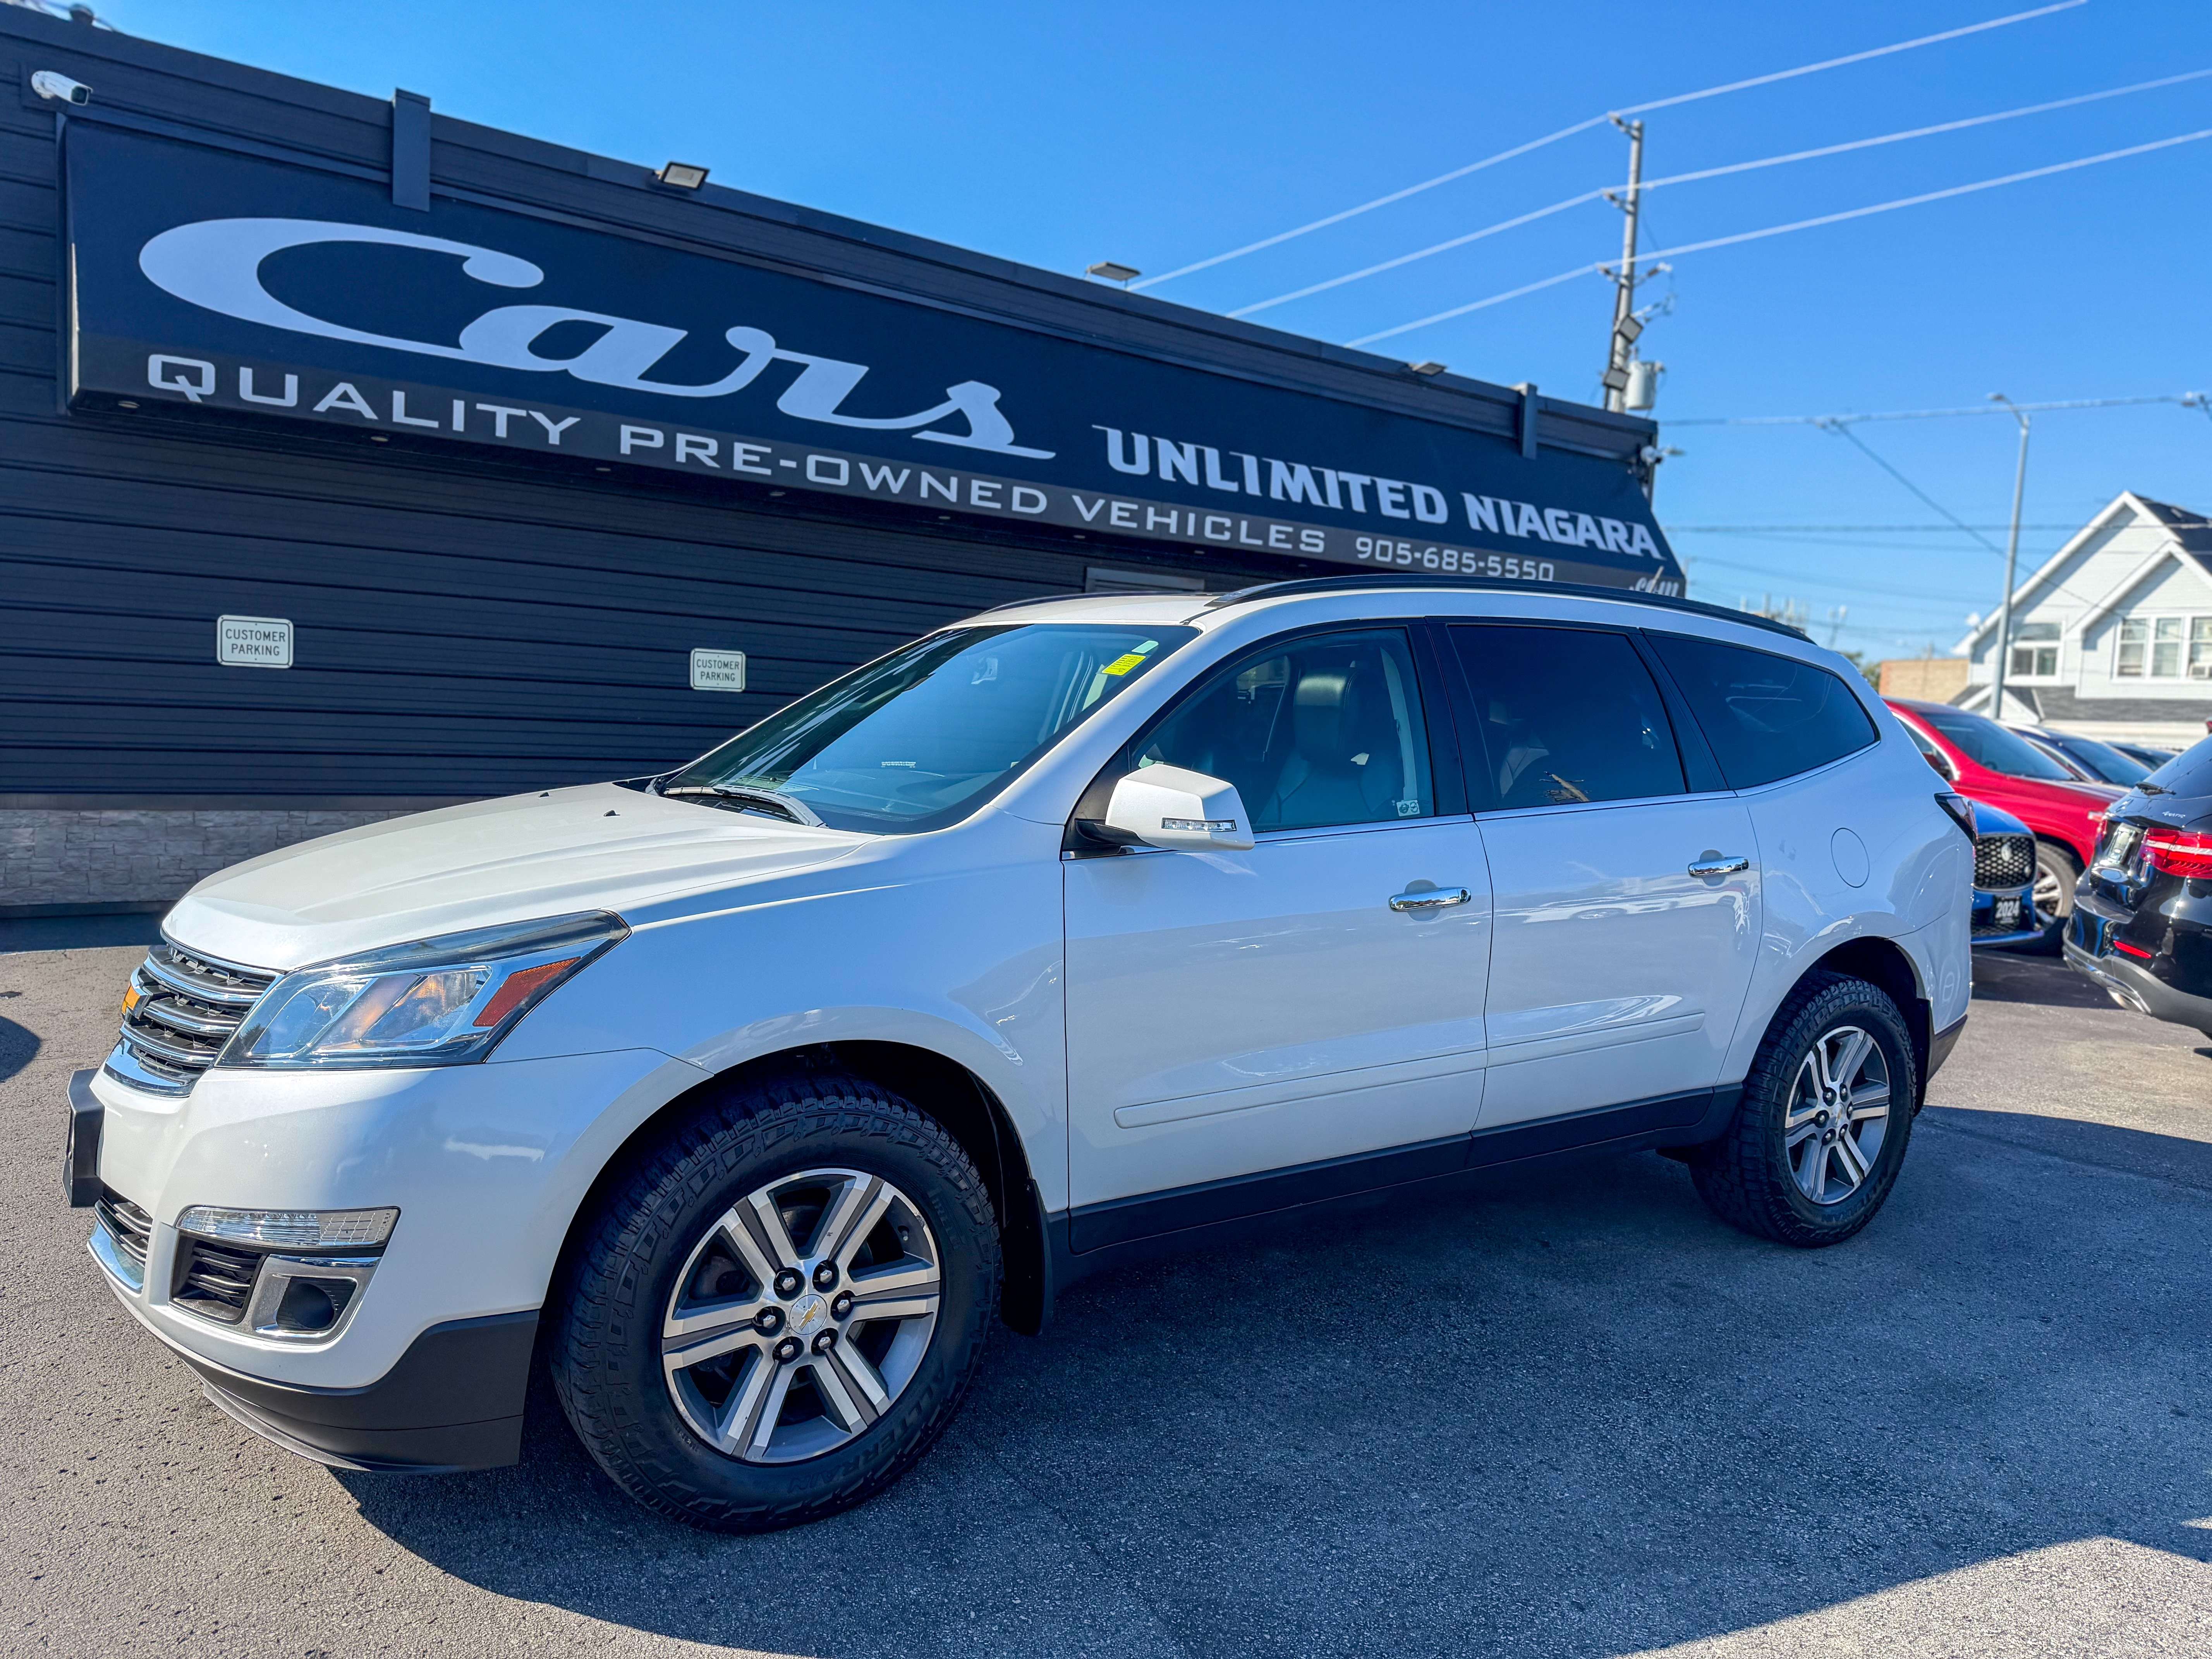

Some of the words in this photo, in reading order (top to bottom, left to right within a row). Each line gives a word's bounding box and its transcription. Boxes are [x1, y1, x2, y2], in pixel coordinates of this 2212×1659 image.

[139, 217, 1056, 460] Cars
[148, 354, 581, 445] QUALITY
[620, 424, 1048, 514] PRE-OWNED
[1072, 495, 1325, 553] VEHICLES
[1091, 424, 1448, 524] UNLIMITED
[1460, 492, 1667, 560] NIAGARA
[1356, 537, 1554, 581] 905-685-5550
[226, 629, 285, 642] CUSTOMER
[232, 644, 280, 656] PARKING
[697, 659, 739, 670] CUSTOMER
[701, 672, 735, 681] PARKING
[1996, 900, 2020, 918] 2024
